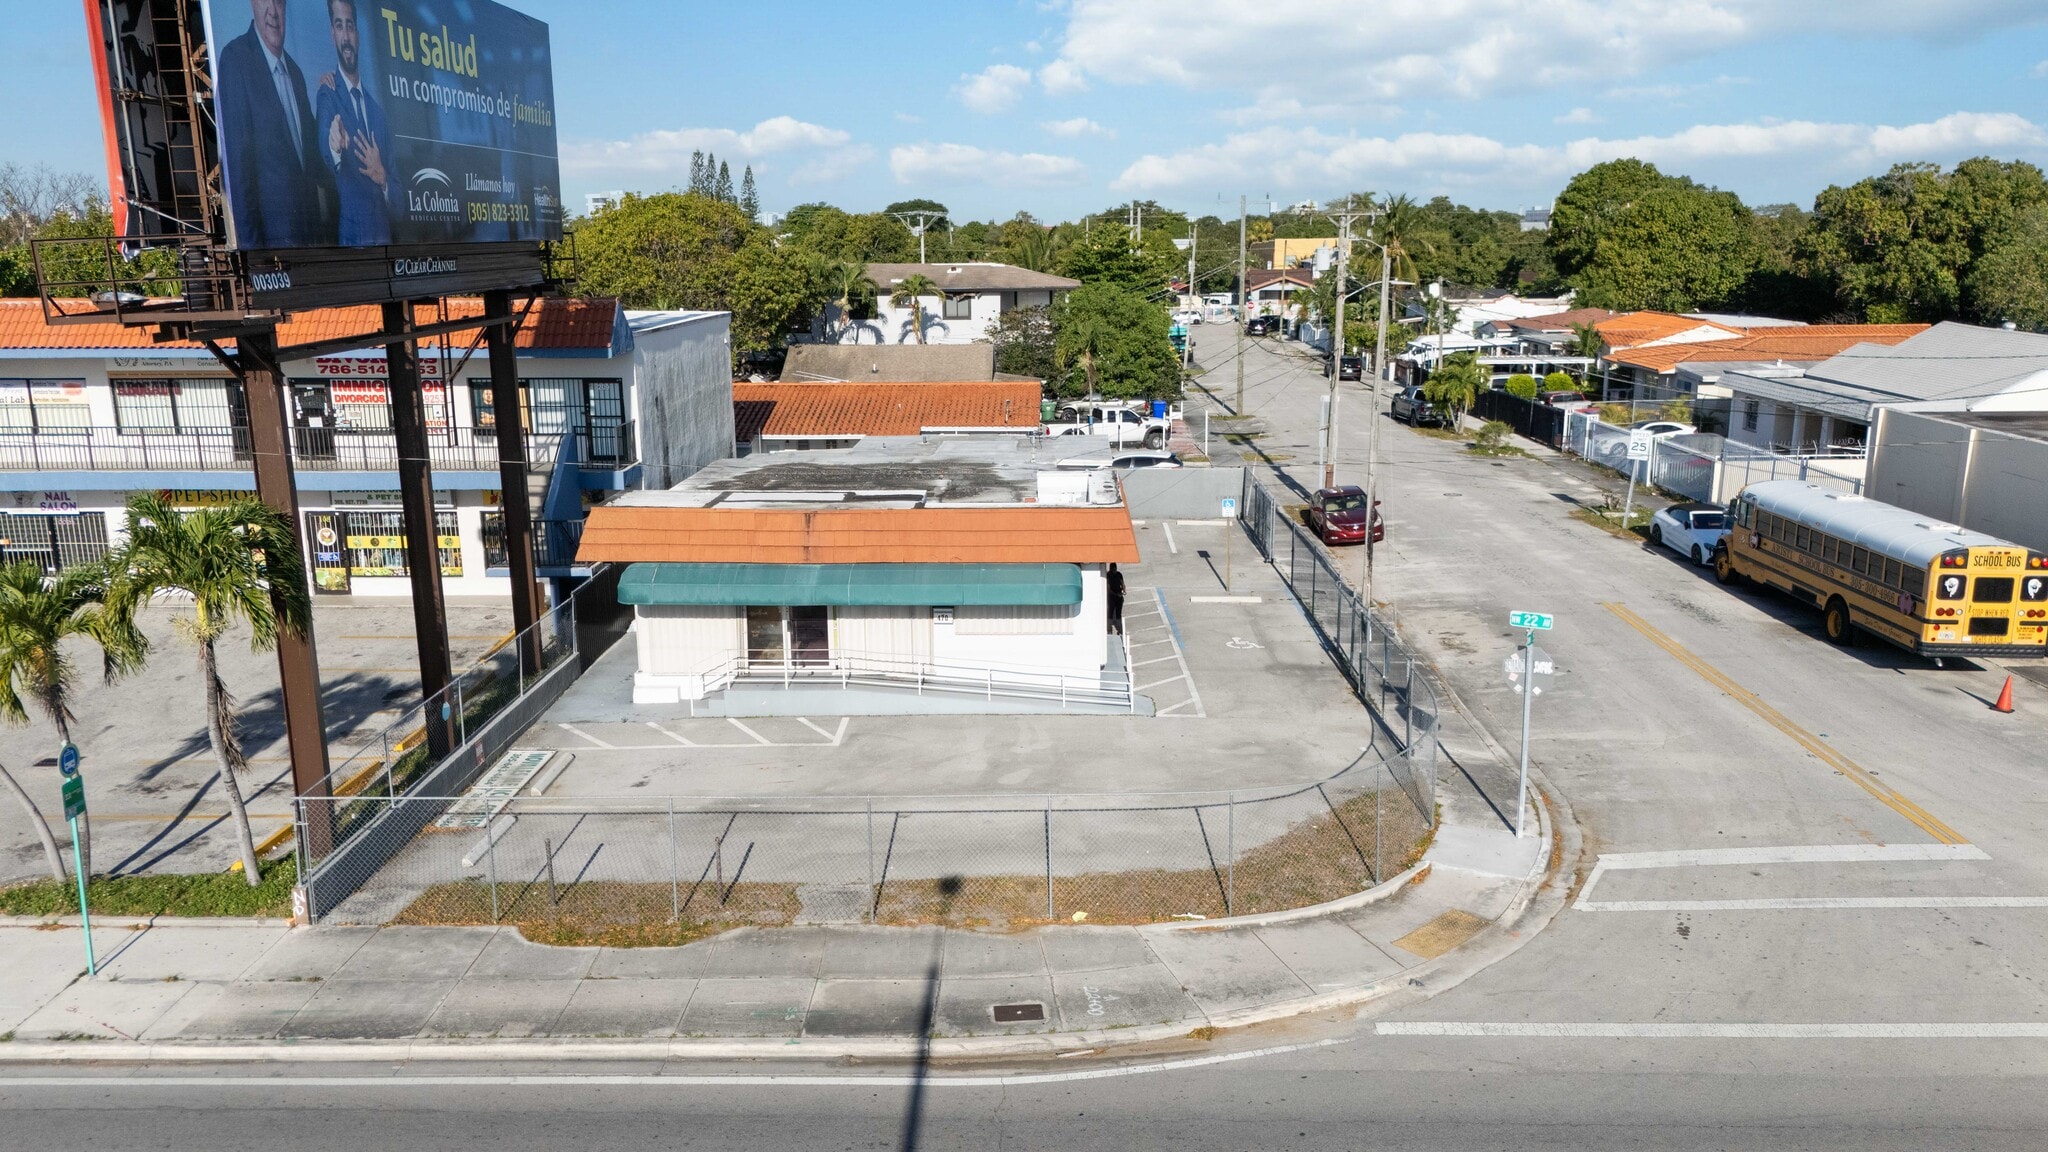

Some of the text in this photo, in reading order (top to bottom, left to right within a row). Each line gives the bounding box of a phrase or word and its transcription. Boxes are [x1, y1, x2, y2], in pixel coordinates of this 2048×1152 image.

[381, 8, 478, 78] Tu salud
[389, 74, 552, 127] un compromiso de familia
[465, 173, 515, 198] Llámanos hoy
[408, 190, 459, 213] La Colonia
[410, 214, 437, 222] MEDICAL
[467, 202, 529, 224] (305) 823-3312
[253, 272, 291, 292] 003039
[10, 396, 26, 404] Lab
[334, 395, 385, 403] DIVORCIOS
[1631, 442, 1647, 451] 25
[44, 491, 71, 501] NAIL
[174, 489, 203, 502] PET
[40, 502, 77, 511] SALON
[1973, 555, 2021, 567] SCHOOL BUS
[1523, 614, 1538, 627] 22
